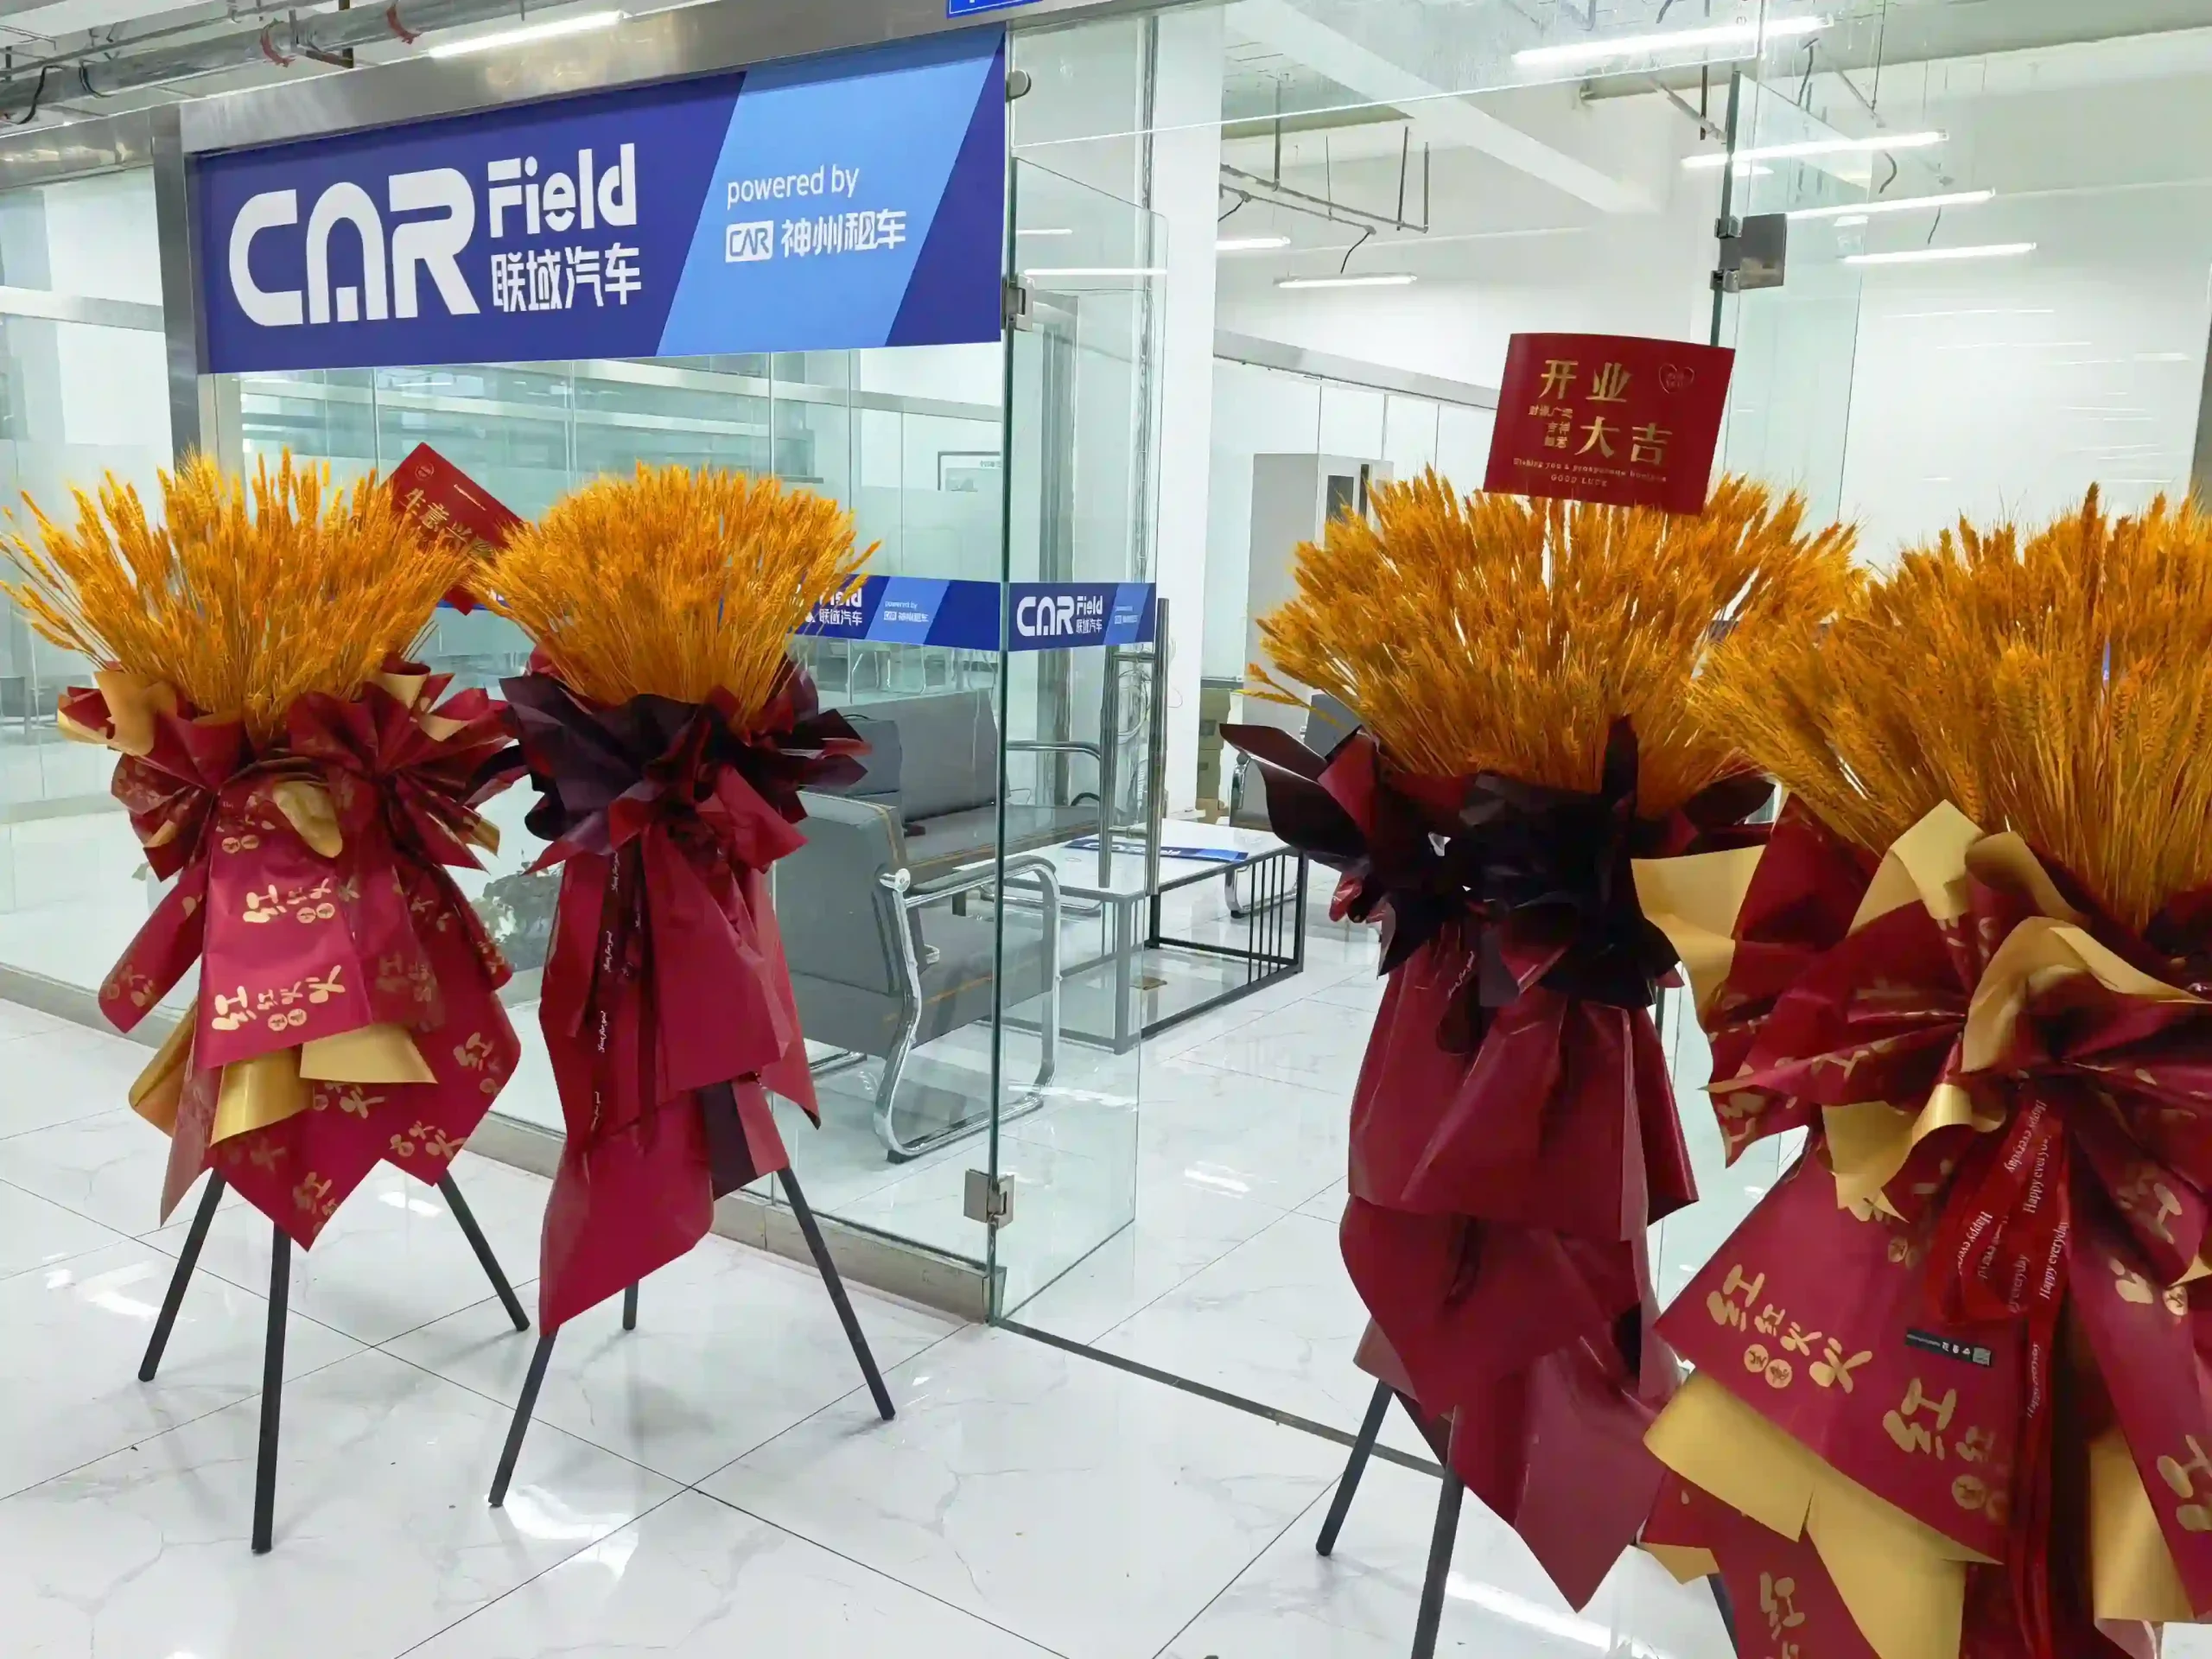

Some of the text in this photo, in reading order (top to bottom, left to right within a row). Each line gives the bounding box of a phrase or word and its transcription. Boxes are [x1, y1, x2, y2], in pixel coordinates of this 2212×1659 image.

[728, 163, 860, 210] powered by
[229, 143, 638, 327] CAR Field
[729, 227, 770, 257] CAR
[781, 208, 906, 257] 神州租车
[491, 245, 641, 312] 联域汽车
[1538, 359, 1633, 403] 开业
[1573, 416, 1673, 466] 大吉
[398, 487, 494, 555] 生意兴
[1017, 595, 1103, 637] CAR Field
[2023, 1179, 2044, 1214] Happy
[1967, 1211, 1993, 1243] Happy
[2039, 1264, 2057, 1300] Happy
